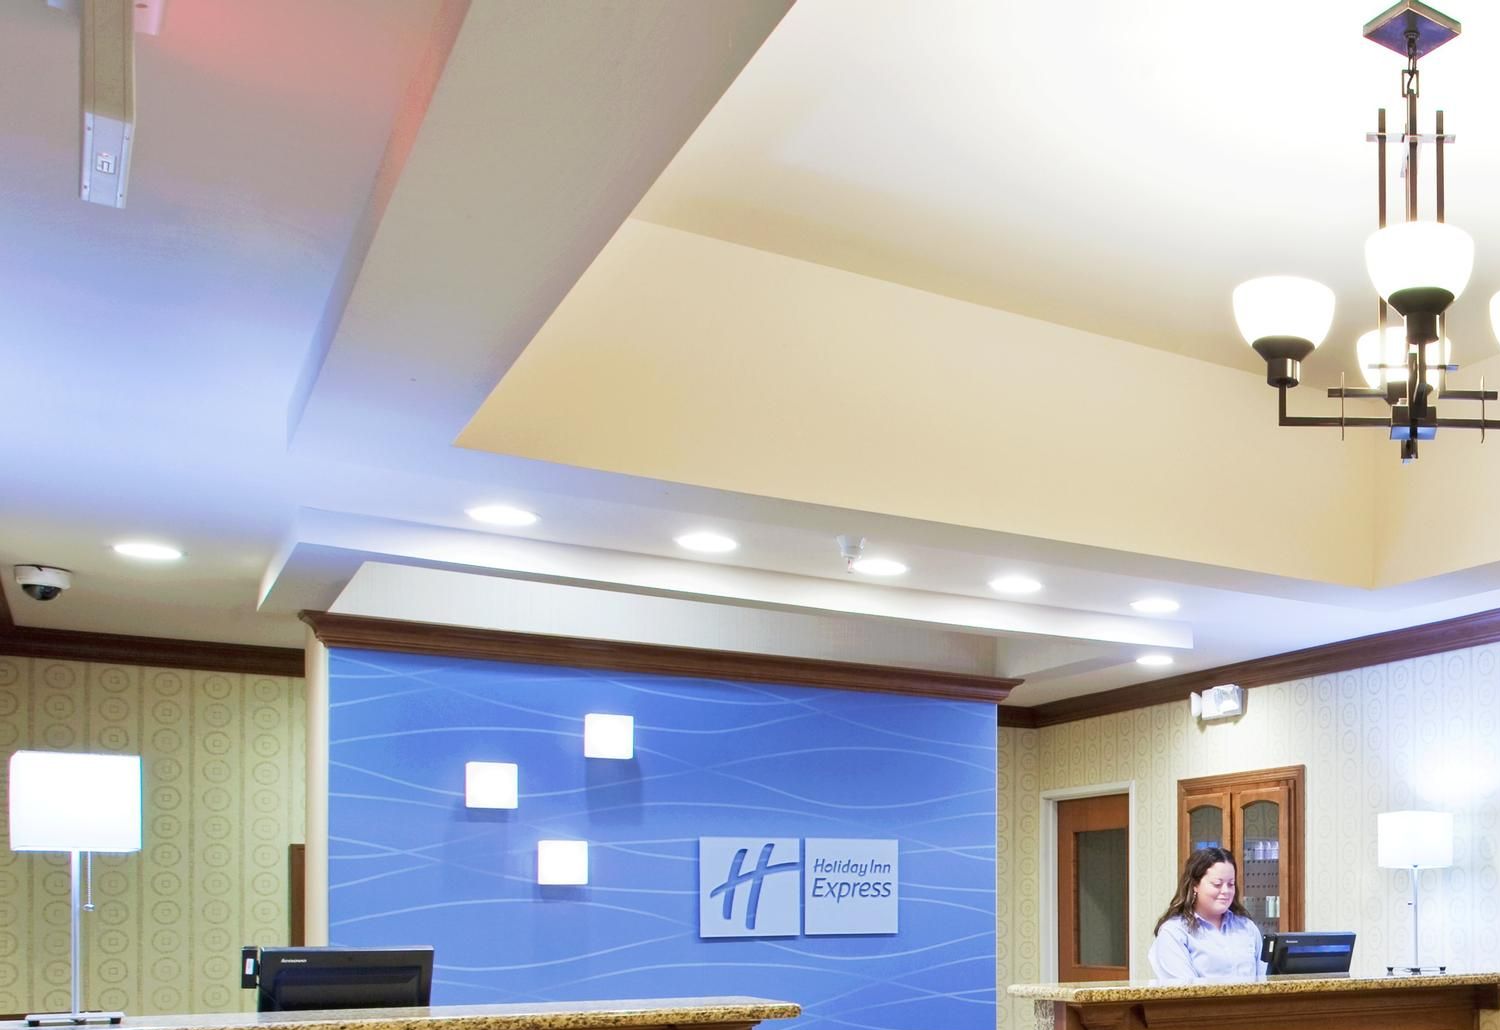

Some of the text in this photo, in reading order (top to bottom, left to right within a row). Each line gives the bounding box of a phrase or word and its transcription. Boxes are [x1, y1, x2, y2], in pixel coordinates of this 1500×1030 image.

[814, 858, 891, 877] Holiday Inn
[812, 877, 892, 904] Express
